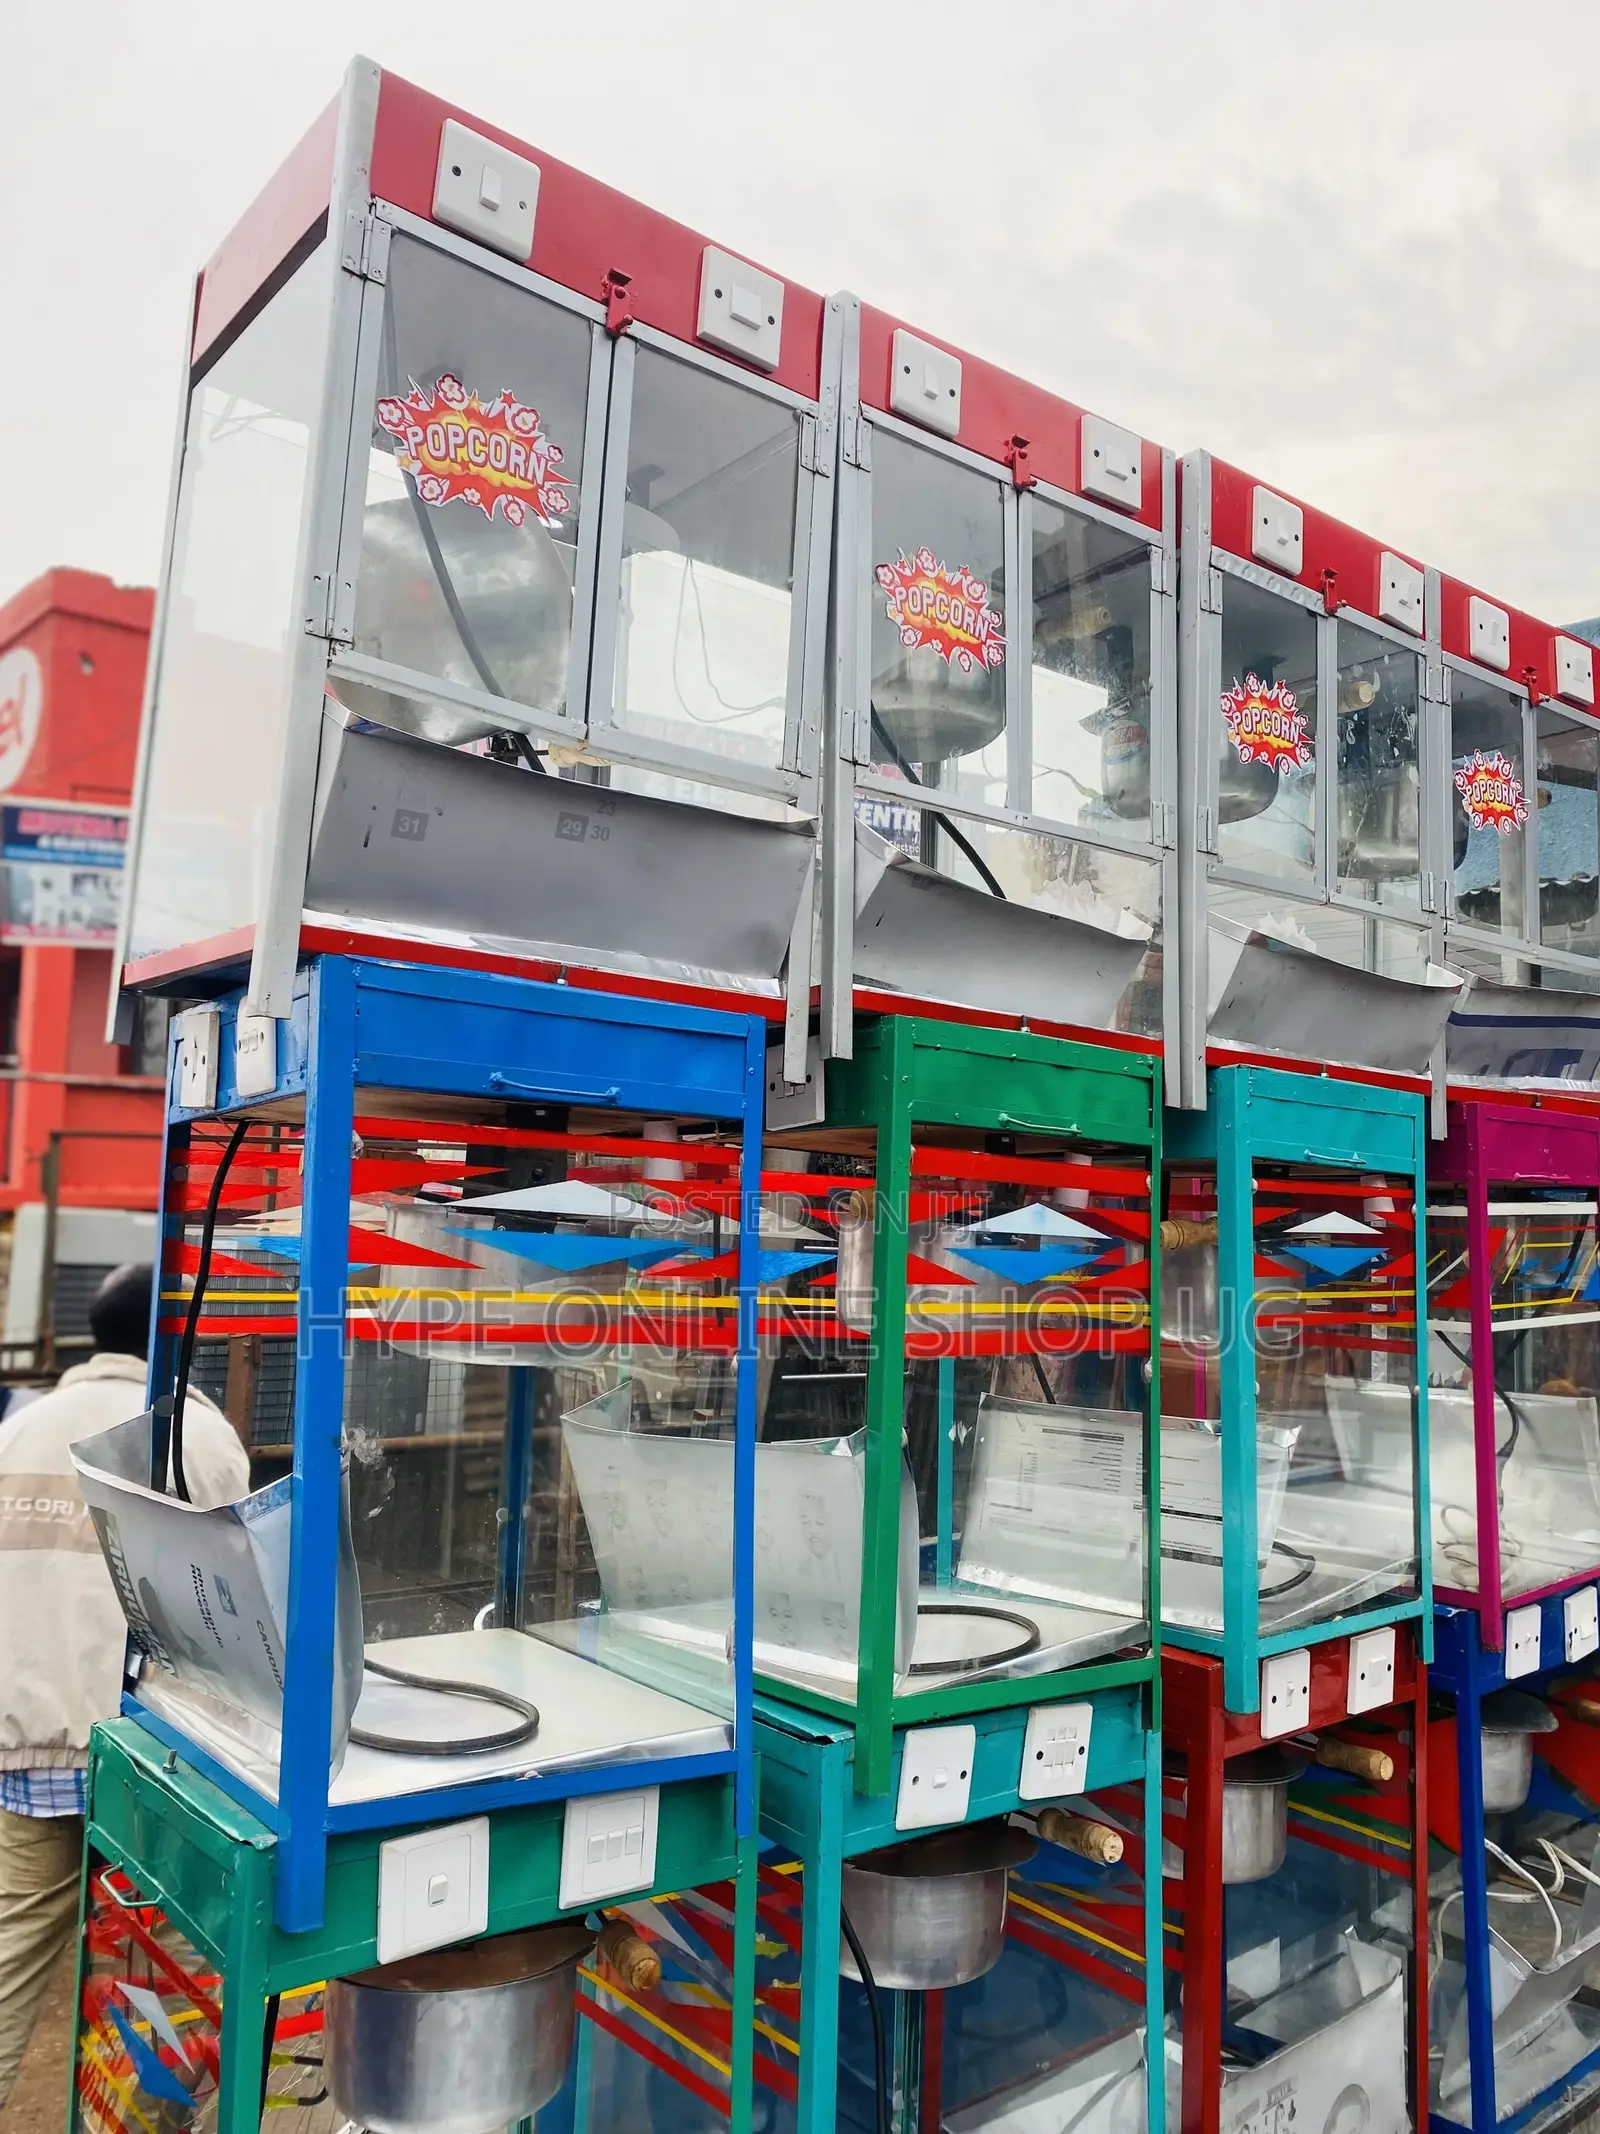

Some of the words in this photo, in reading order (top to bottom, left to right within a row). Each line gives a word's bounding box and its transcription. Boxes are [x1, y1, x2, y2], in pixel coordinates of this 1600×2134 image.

[405, 422, 547, 487] POPCORN
[893, 585, 990, 643] POPCORN
[1232, 706, 1299, 746] POPCORN
[1465, 778, 1517, 807] POPCORN
[398, 815, 421, 835] 31
[560, 819, 582, 837] 29
[590, 825, 611, 842] 30
